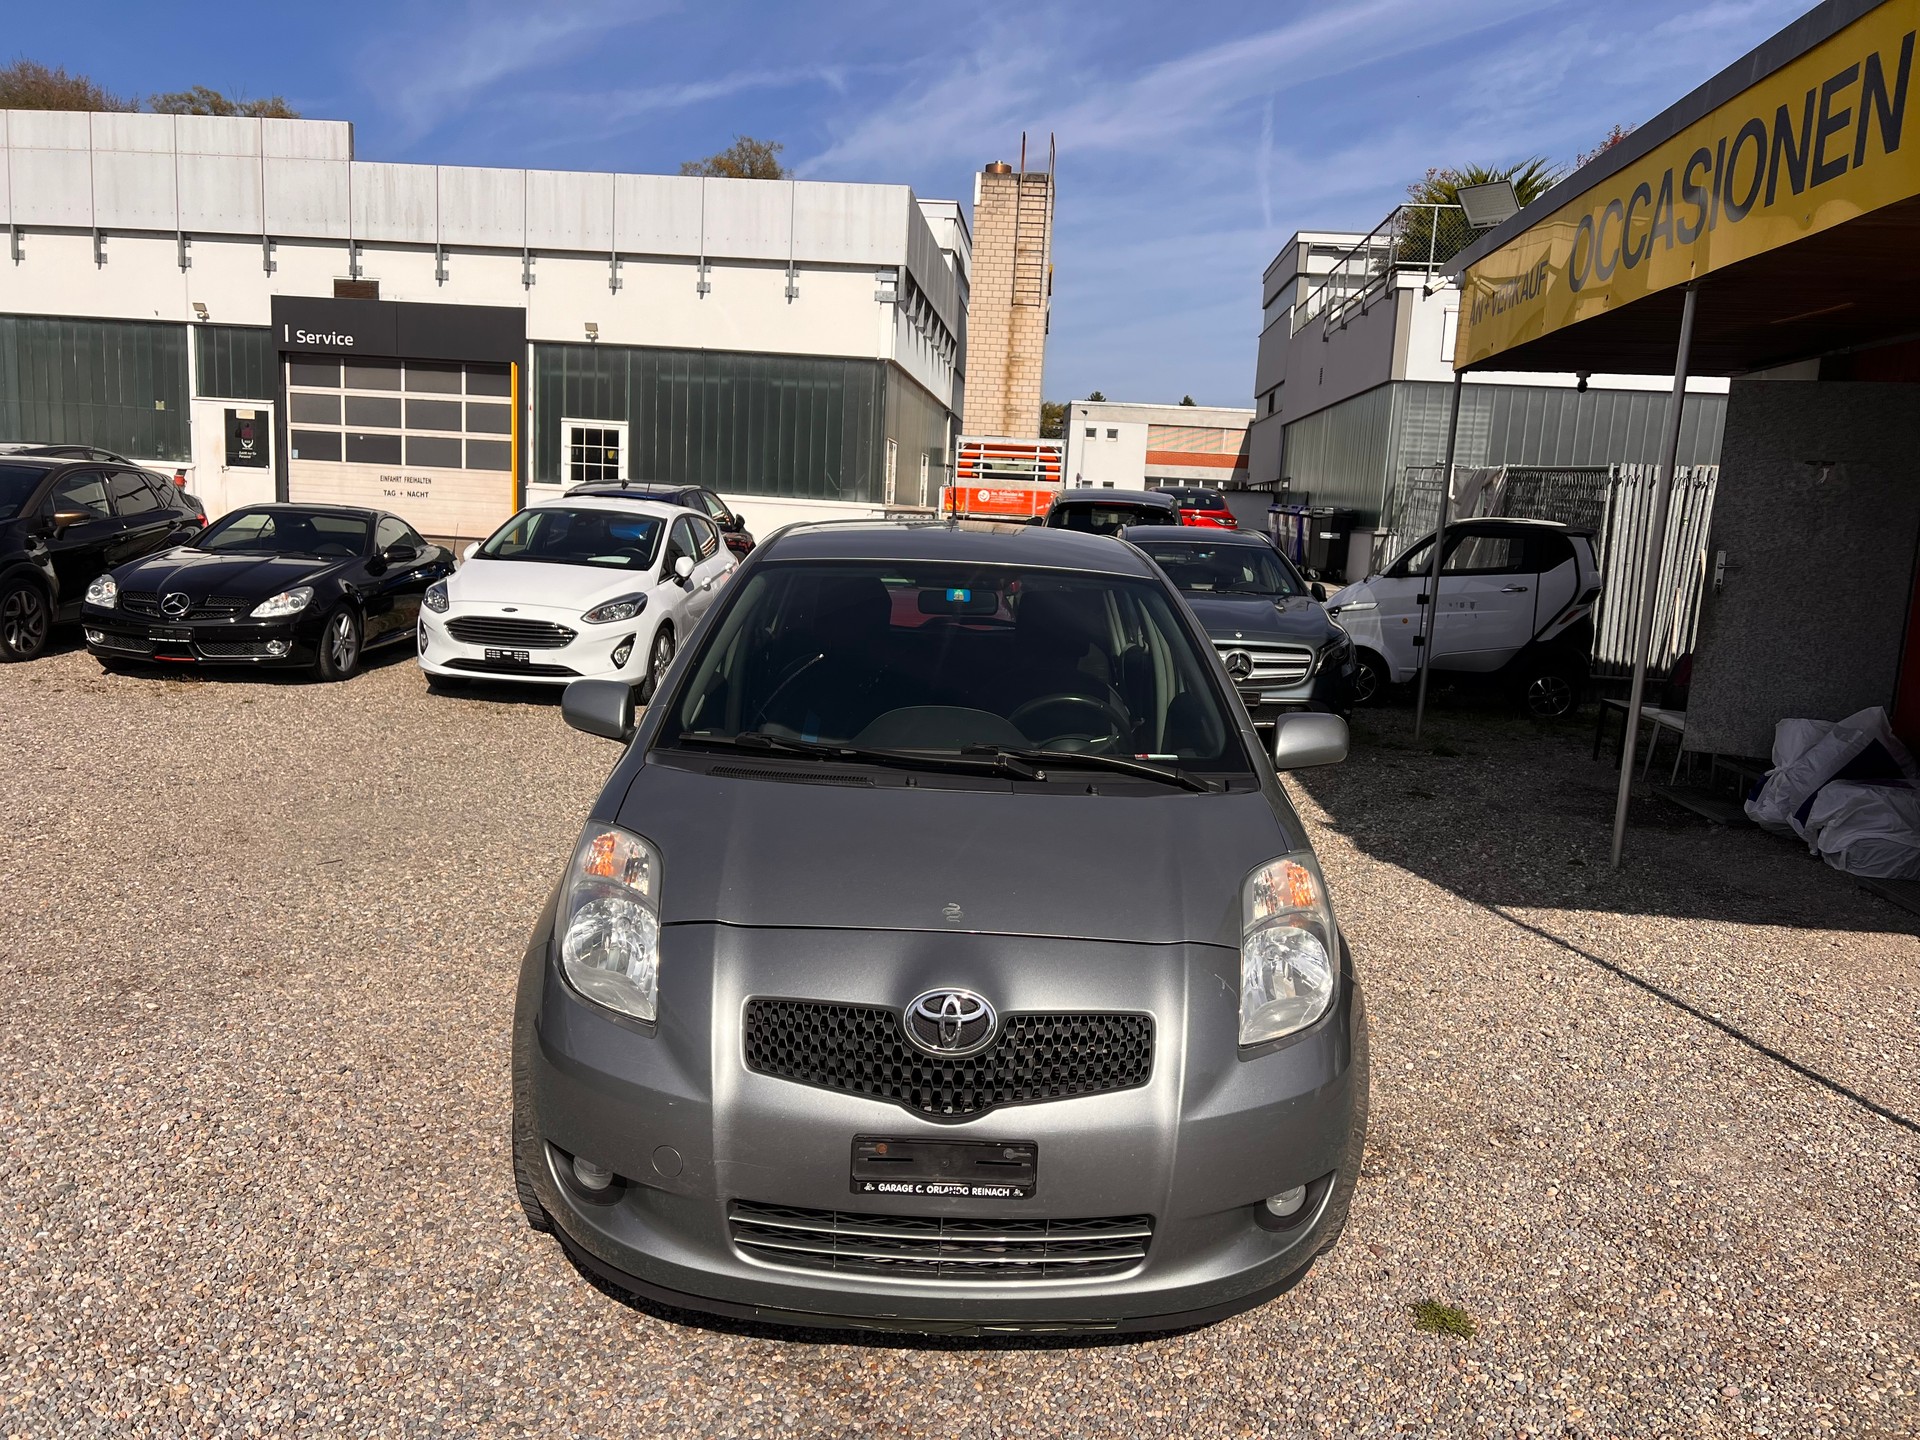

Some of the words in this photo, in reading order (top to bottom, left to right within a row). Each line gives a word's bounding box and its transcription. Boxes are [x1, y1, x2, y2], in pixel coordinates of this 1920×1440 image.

[1568, 29, 1917, 293] OCCASIONEN
[296, 329, 354, 346] Service
[380, 475, 402, 483] EINFAHRT
[384, 489, 396, 497] TAG
[878, 1182, 914, 1194] GARAGE
[915, 1185, 925, 1194] C.
[926, 1185, 970, 1196] ORLANDO
[971, 1187, 1010, 1197] REINACH
